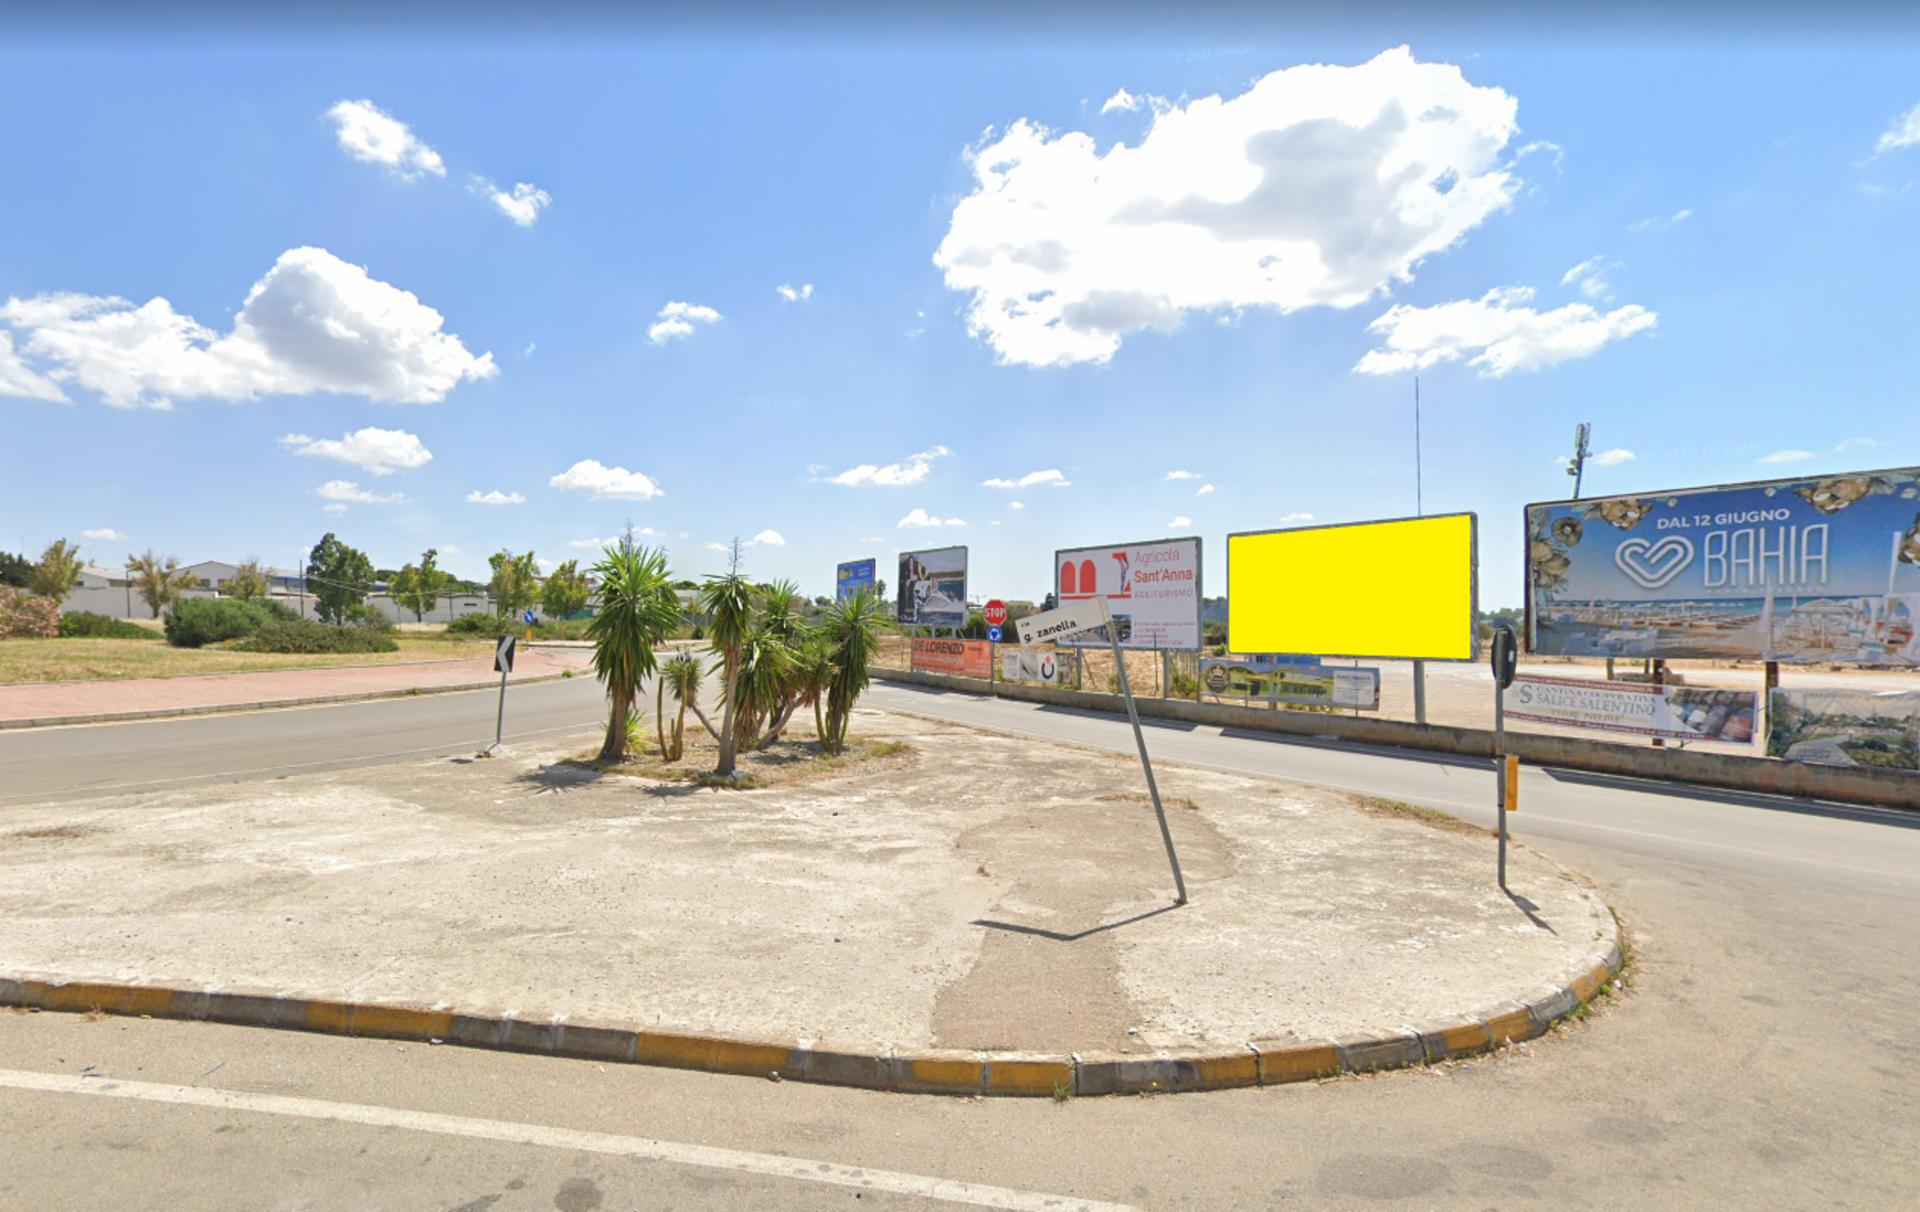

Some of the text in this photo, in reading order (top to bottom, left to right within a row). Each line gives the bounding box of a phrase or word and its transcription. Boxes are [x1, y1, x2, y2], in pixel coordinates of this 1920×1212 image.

[1657, 508, 1790, 529] DAL 12 GIUGNO
[1134, 547, 1180, 565] Agricola
[1703, 523, 1829, 587] BAHIA
[1134, 568, 1193, 584] Sant'Anna
[1134, 588, 1193, 599] AGRITURISMO
[985, 607, 1006, 618] STOP
[1036, 619, 1078, 638] zanella
[914, 640, 925, 652] DE
[925, 641, 965, 655] LORENZO
[1536, 693, 1578, 707] SALICE
[1580, 699, 1656, 717] SALENTINO
